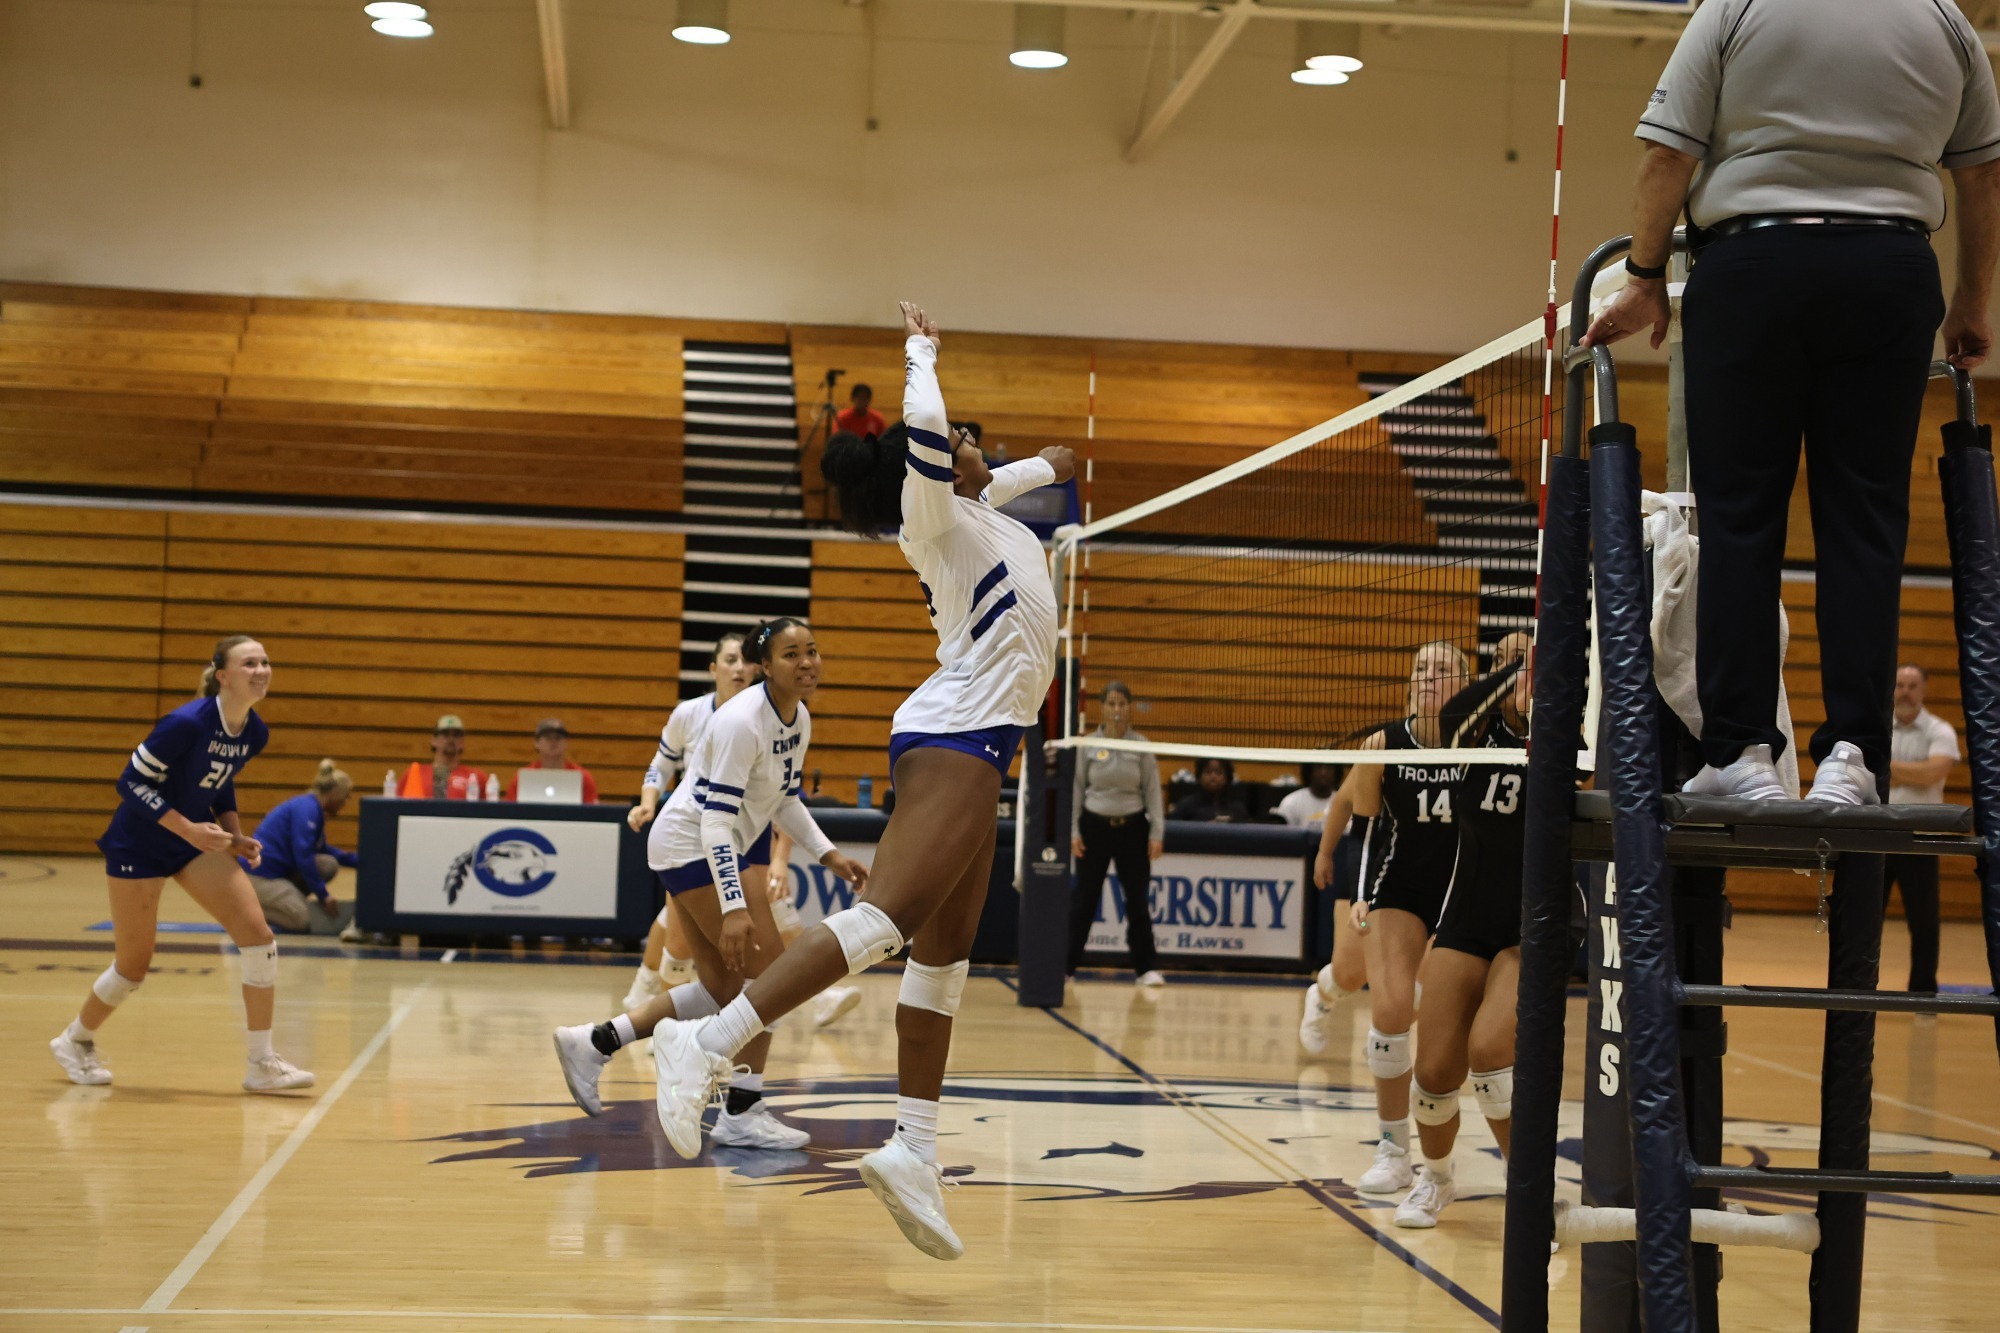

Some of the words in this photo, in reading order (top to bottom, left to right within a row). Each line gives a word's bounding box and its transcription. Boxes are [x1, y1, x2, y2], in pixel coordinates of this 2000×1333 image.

[199, 760, 232, 789] 21
[1397, 764, 1461, 783] TROJAN
[1416, 788, 1452, 823] 14
[1480, 772, 1522, 814] 13
[712, 844, 743, 902] HAWKS
